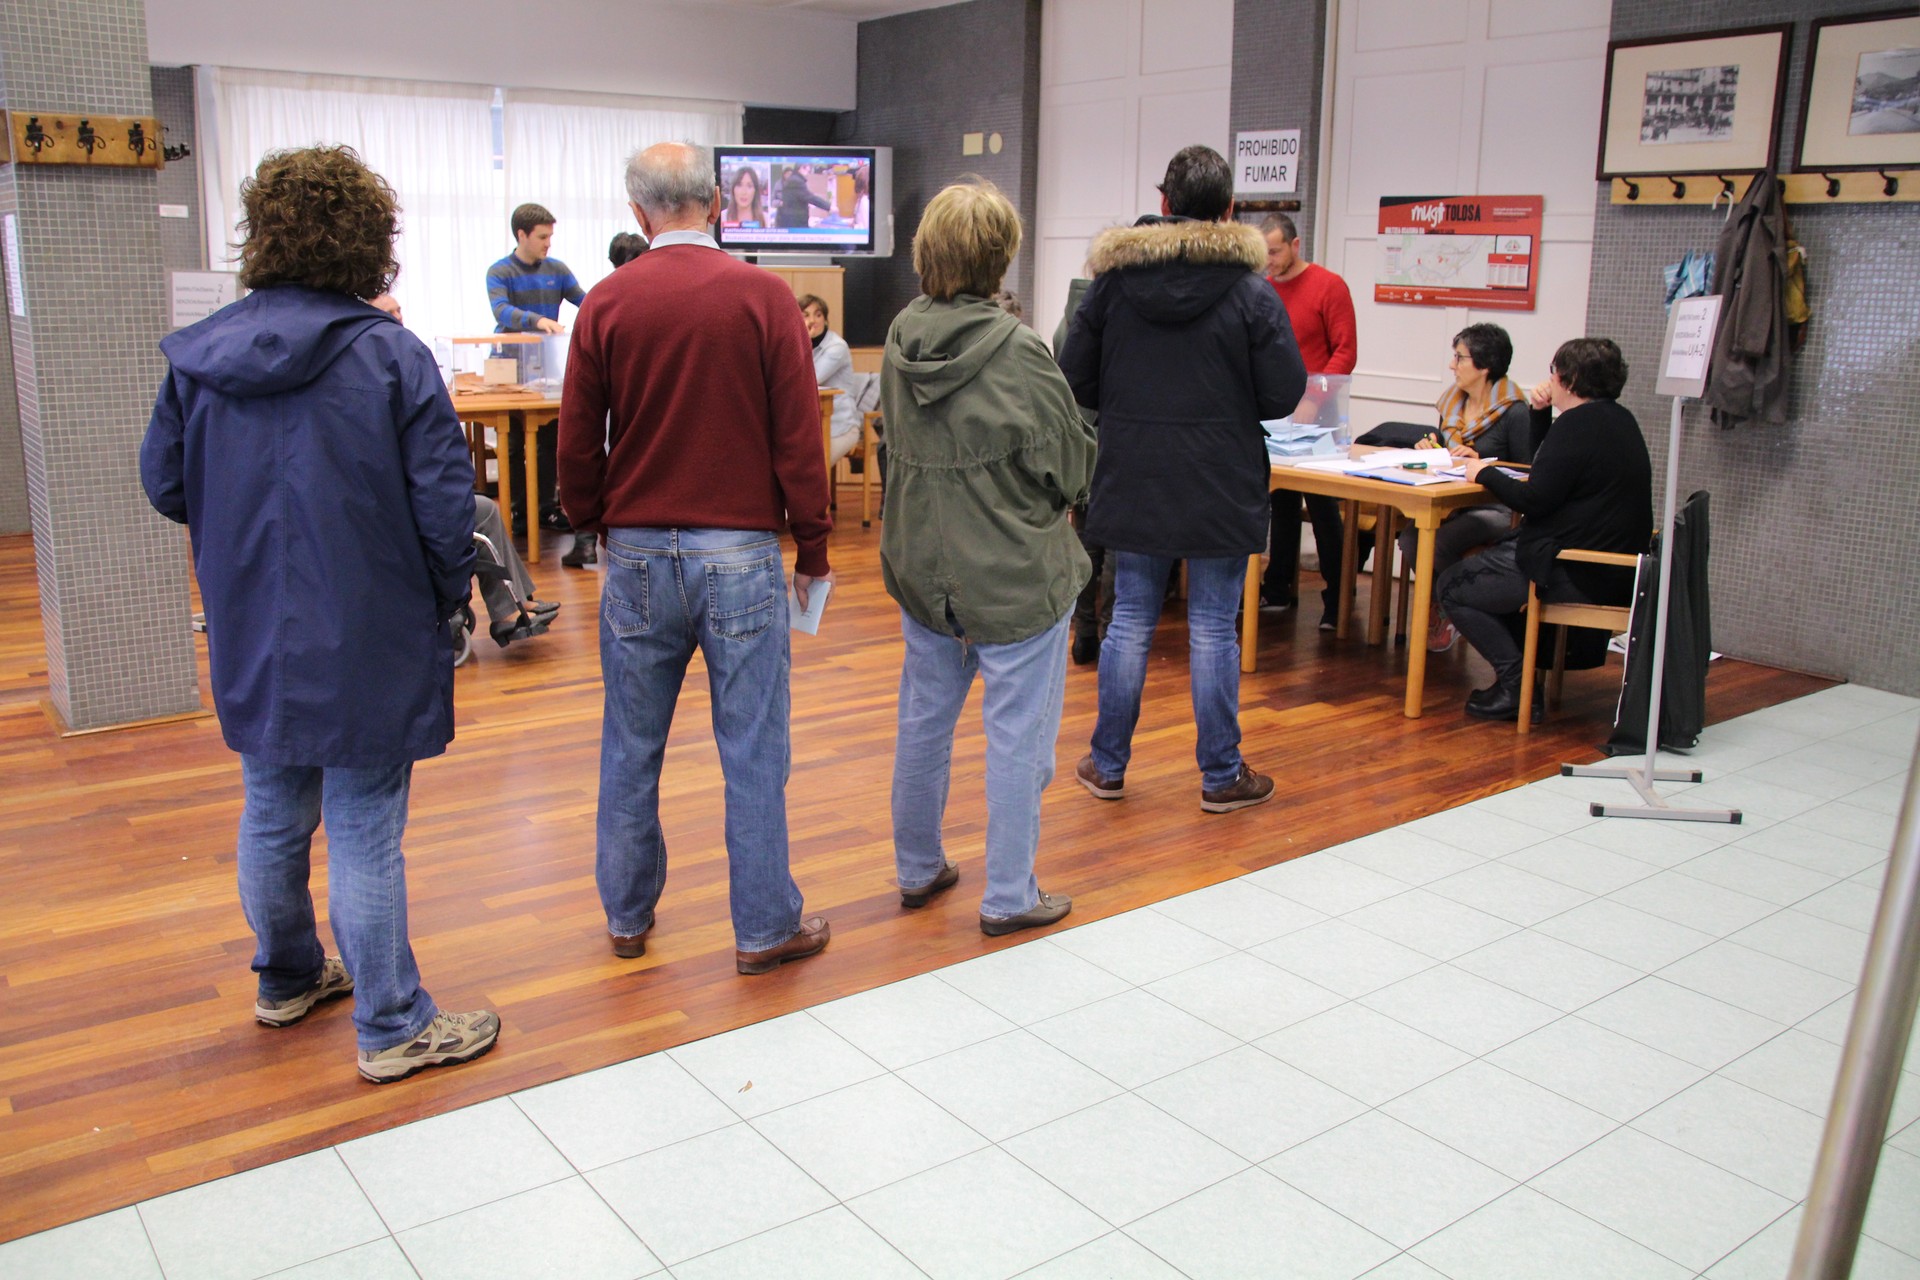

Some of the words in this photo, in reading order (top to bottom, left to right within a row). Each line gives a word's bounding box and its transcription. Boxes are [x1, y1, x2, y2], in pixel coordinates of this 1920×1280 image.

[1238, 138, 1298, 157] PROHIBIDO
[1244, 165, 1288, 183] FUMAR
[1445, 204, 1481, 222] TOLOSA
